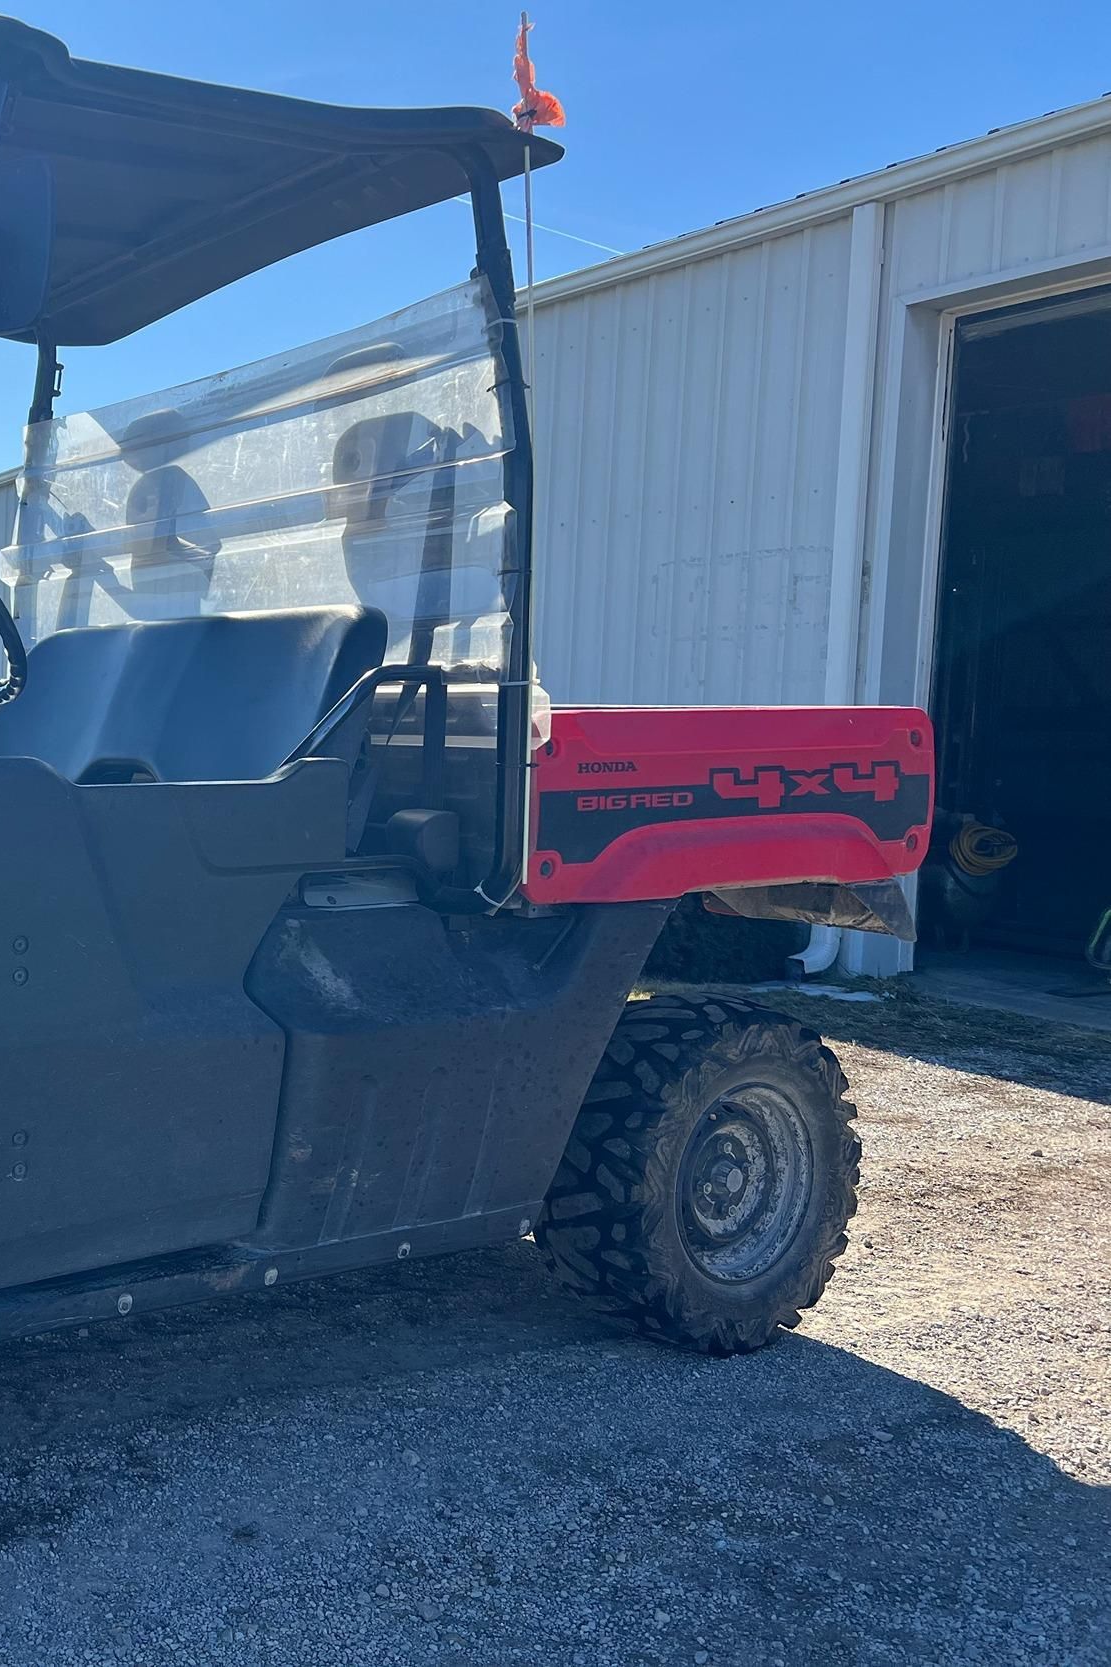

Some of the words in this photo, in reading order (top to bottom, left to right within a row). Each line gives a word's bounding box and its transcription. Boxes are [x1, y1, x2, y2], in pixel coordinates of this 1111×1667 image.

[577, 761, 638, 774] HONDA
[577, 795, 627, 811] BIG
[630, 792, 694, 809] RED
